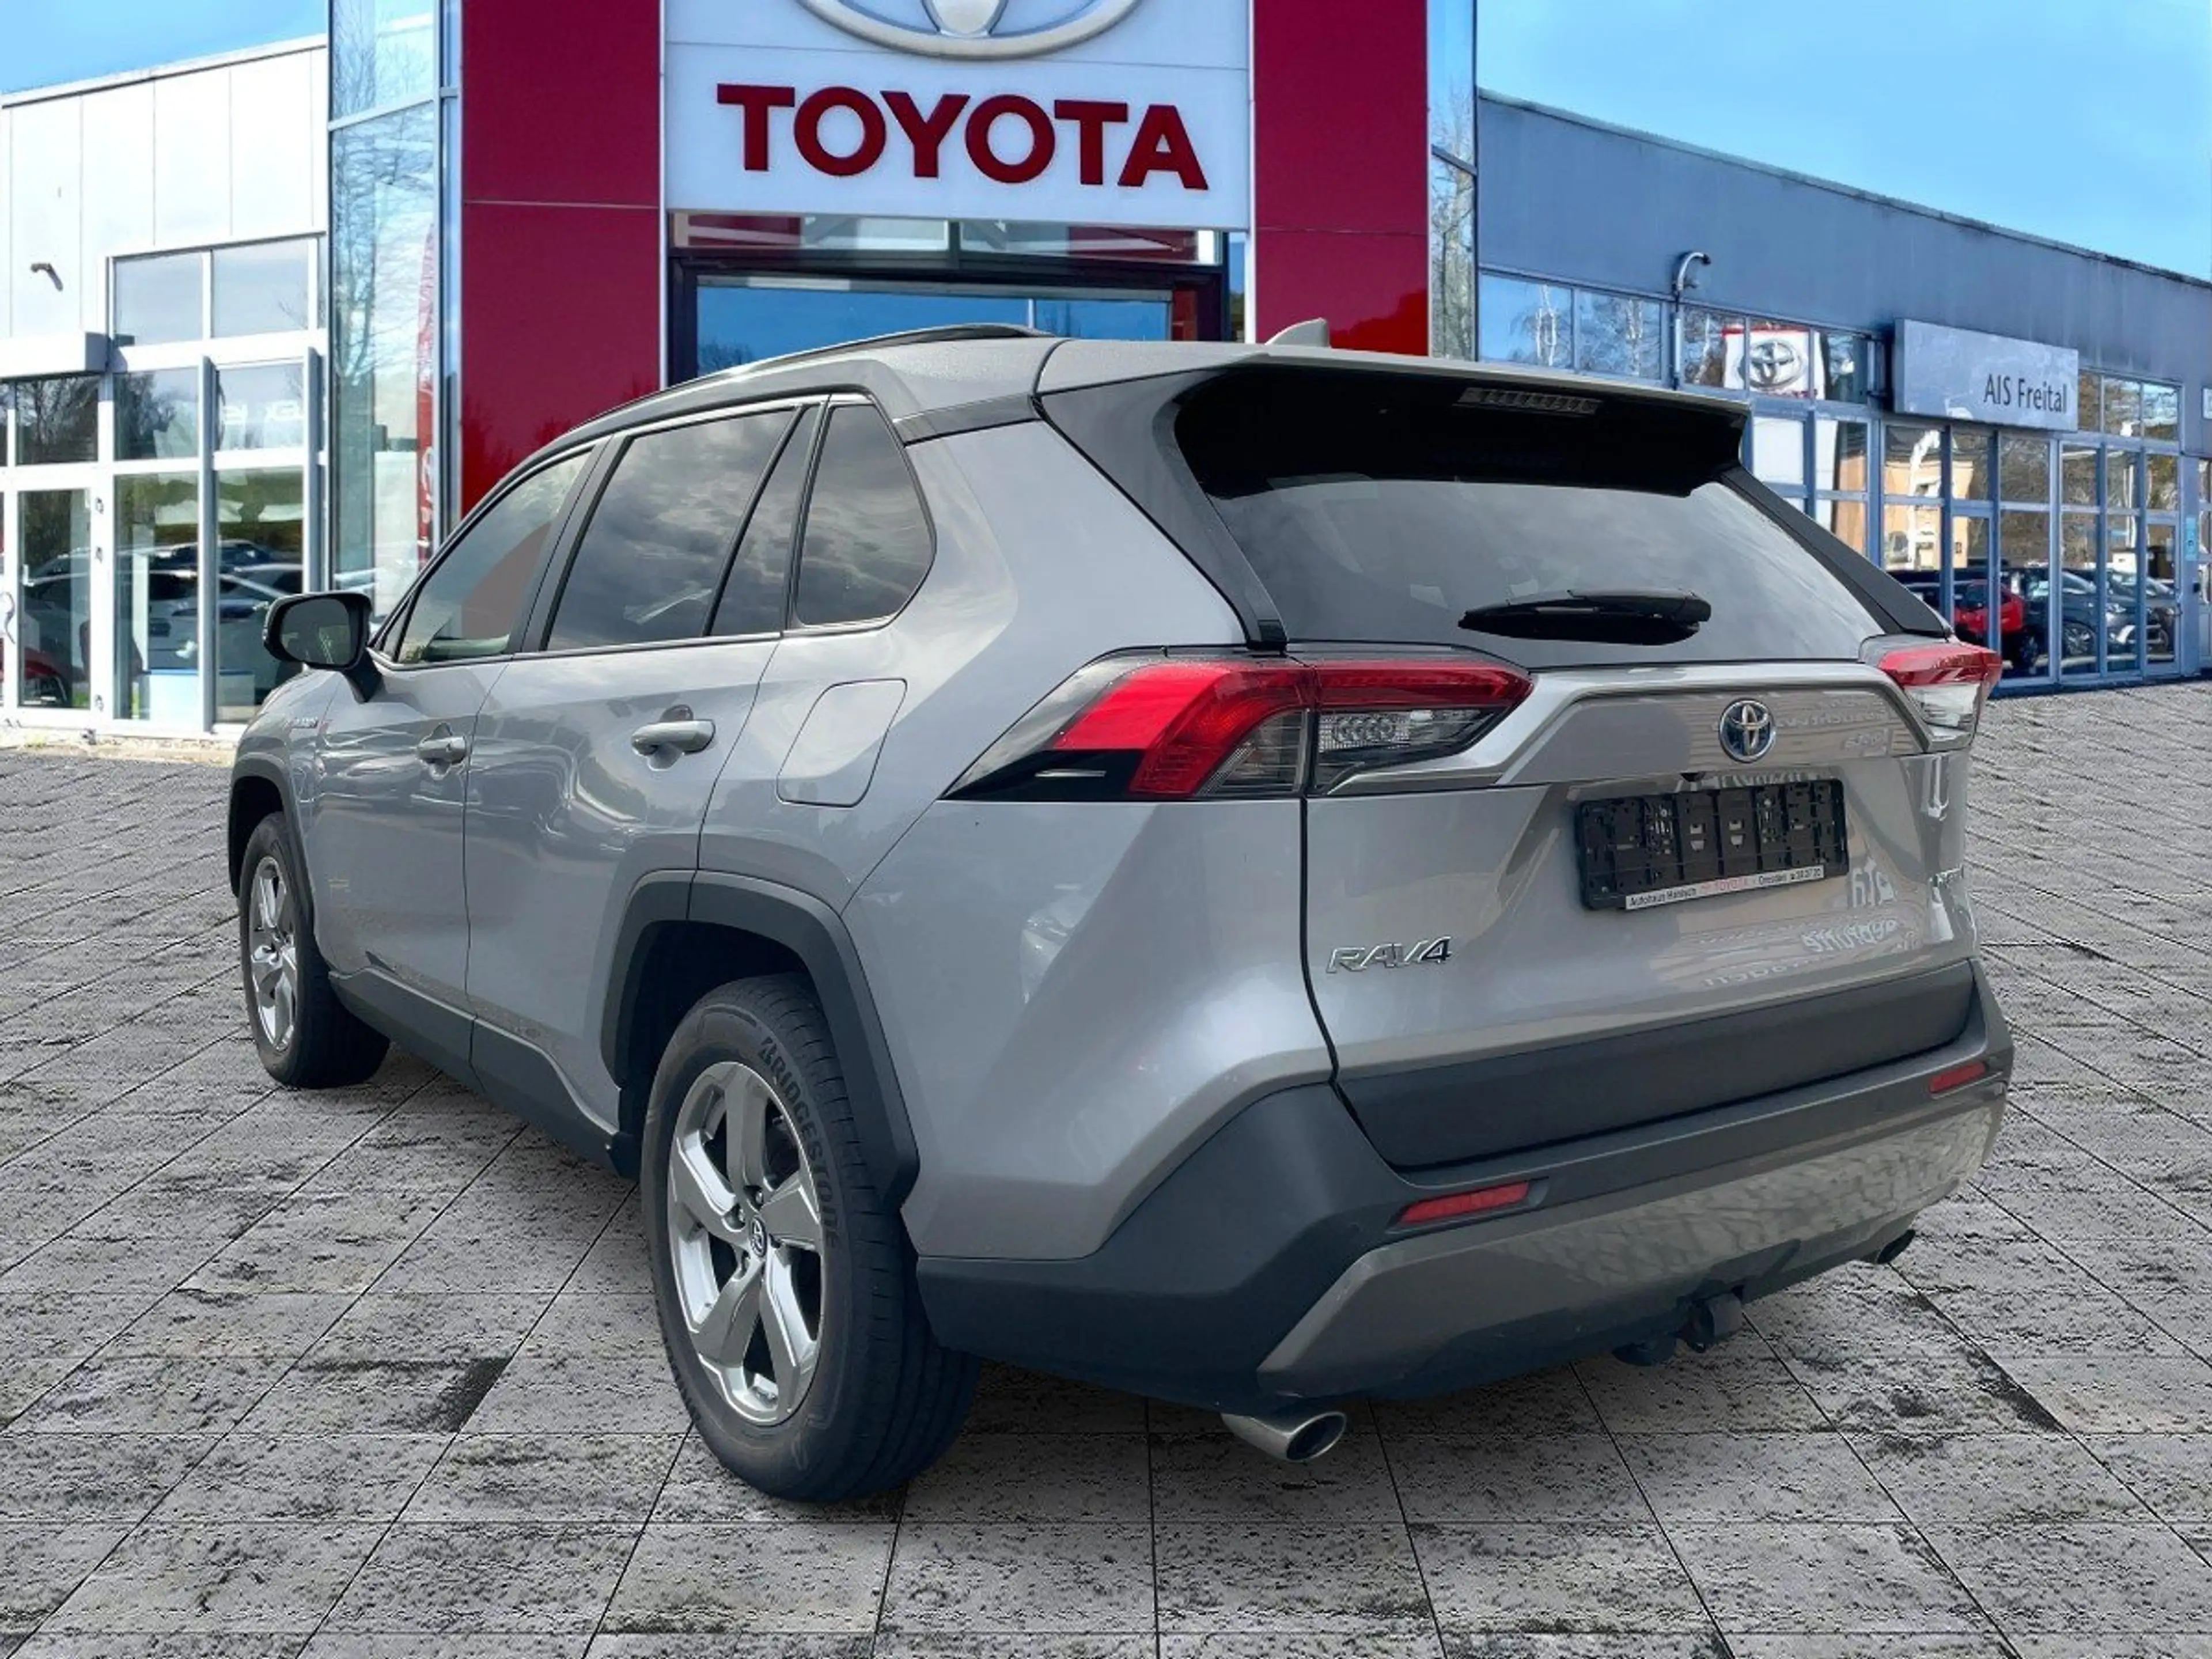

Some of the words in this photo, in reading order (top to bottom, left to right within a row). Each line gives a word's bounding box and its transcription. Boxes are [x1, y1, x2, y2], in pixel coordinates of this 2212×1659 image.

[717, 84, 1209, 190] TOYOTA
[1983, 374, 2011, 406] AIS
[2018, 378, 2067, 414] Freital
[1326, 935, 1453, 974] RAV4
[757, 1036, 838, 1248] BRIDGESTONE
